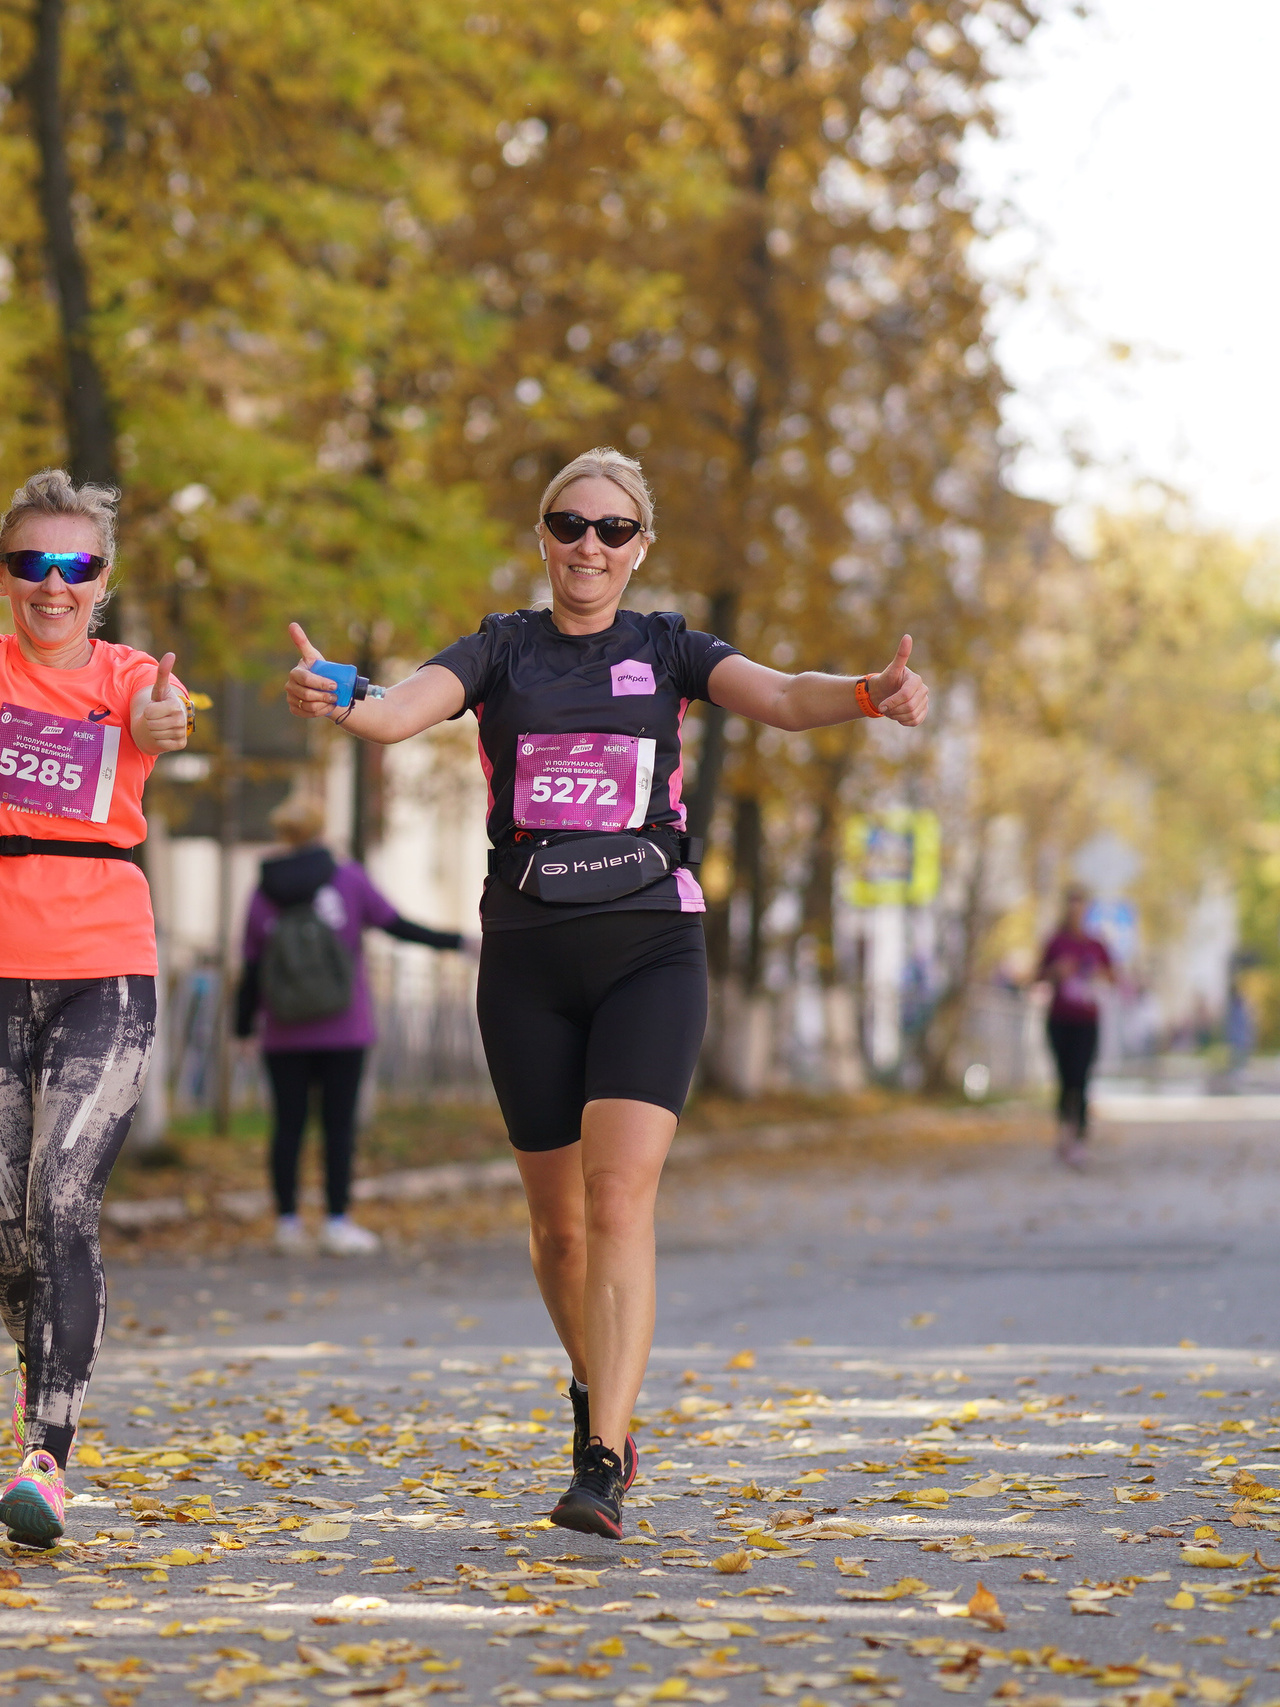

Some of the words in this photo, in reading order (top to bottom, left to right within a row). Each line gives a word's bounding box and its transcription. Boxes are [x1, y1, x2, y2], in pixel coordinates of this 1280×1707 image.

[23, 736, 72, 752] ПОЛУМАРАФОН
[530, 776, 618, 806] 5272
[573, 848, 646, 873] Kalenji
